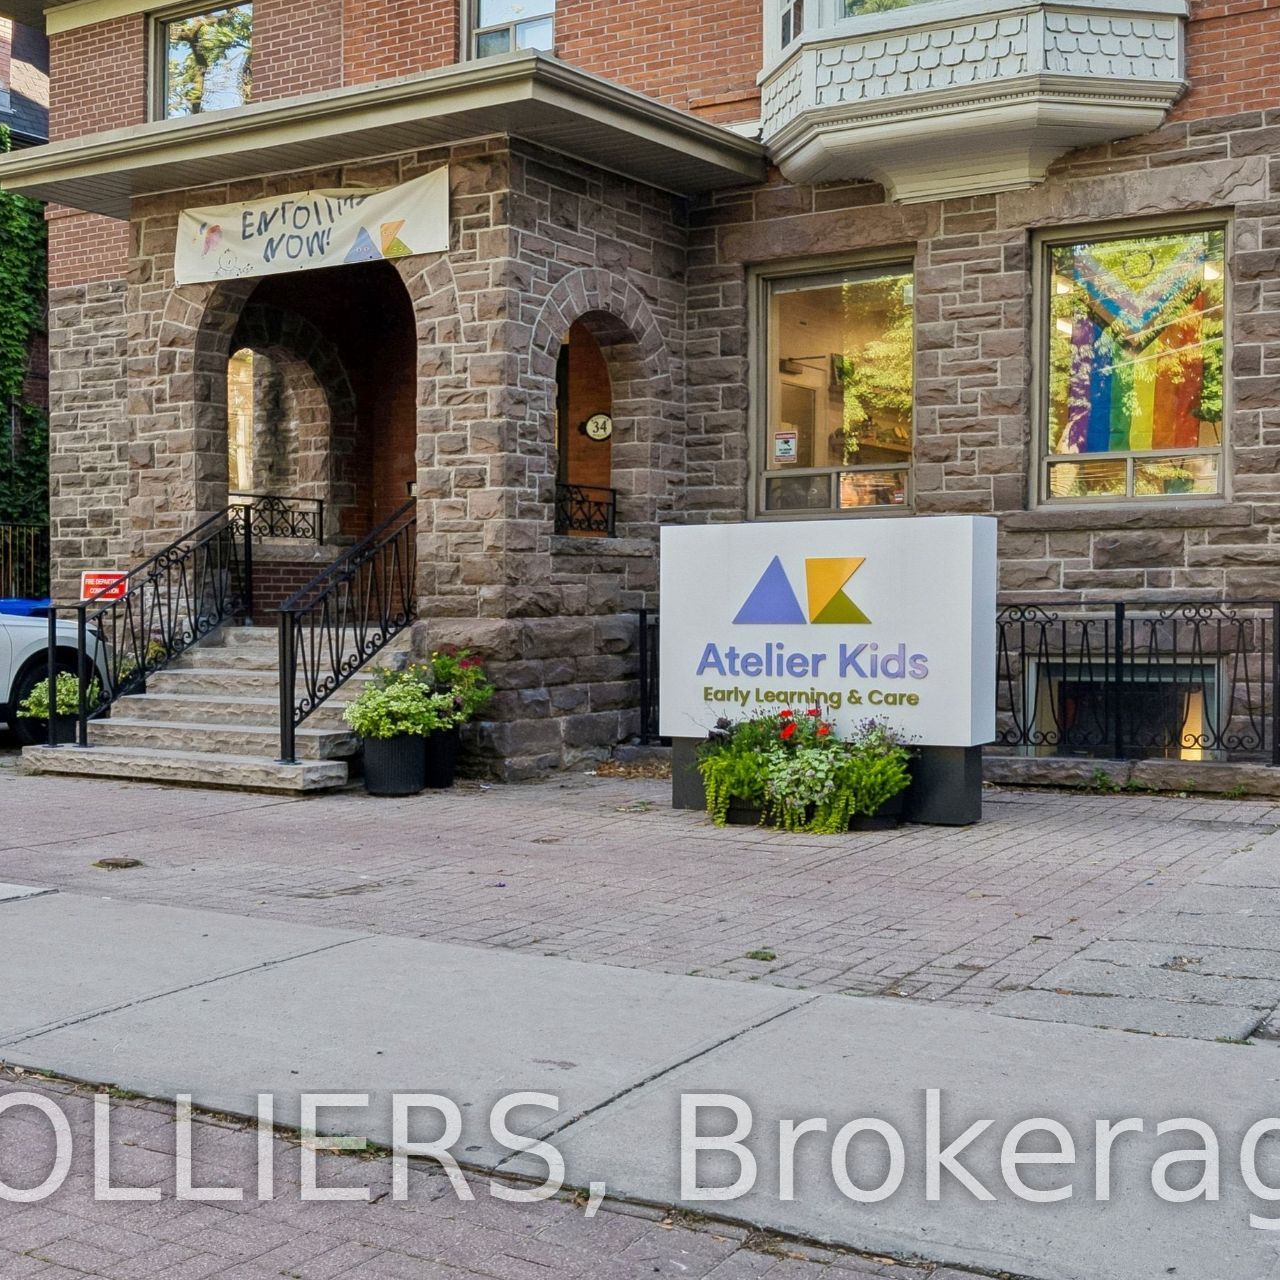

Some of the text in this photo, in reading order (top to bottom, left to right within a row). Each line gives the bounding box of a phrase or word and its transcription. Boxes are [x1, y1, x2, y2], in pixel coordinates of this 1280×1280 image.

[263, 227, 332, 262] NOW!
[592, 420, 607, 433] 34
[696, 642, 929, 680] Atelier Kids
[703, 686, 920, 710] Early Learning & Care
